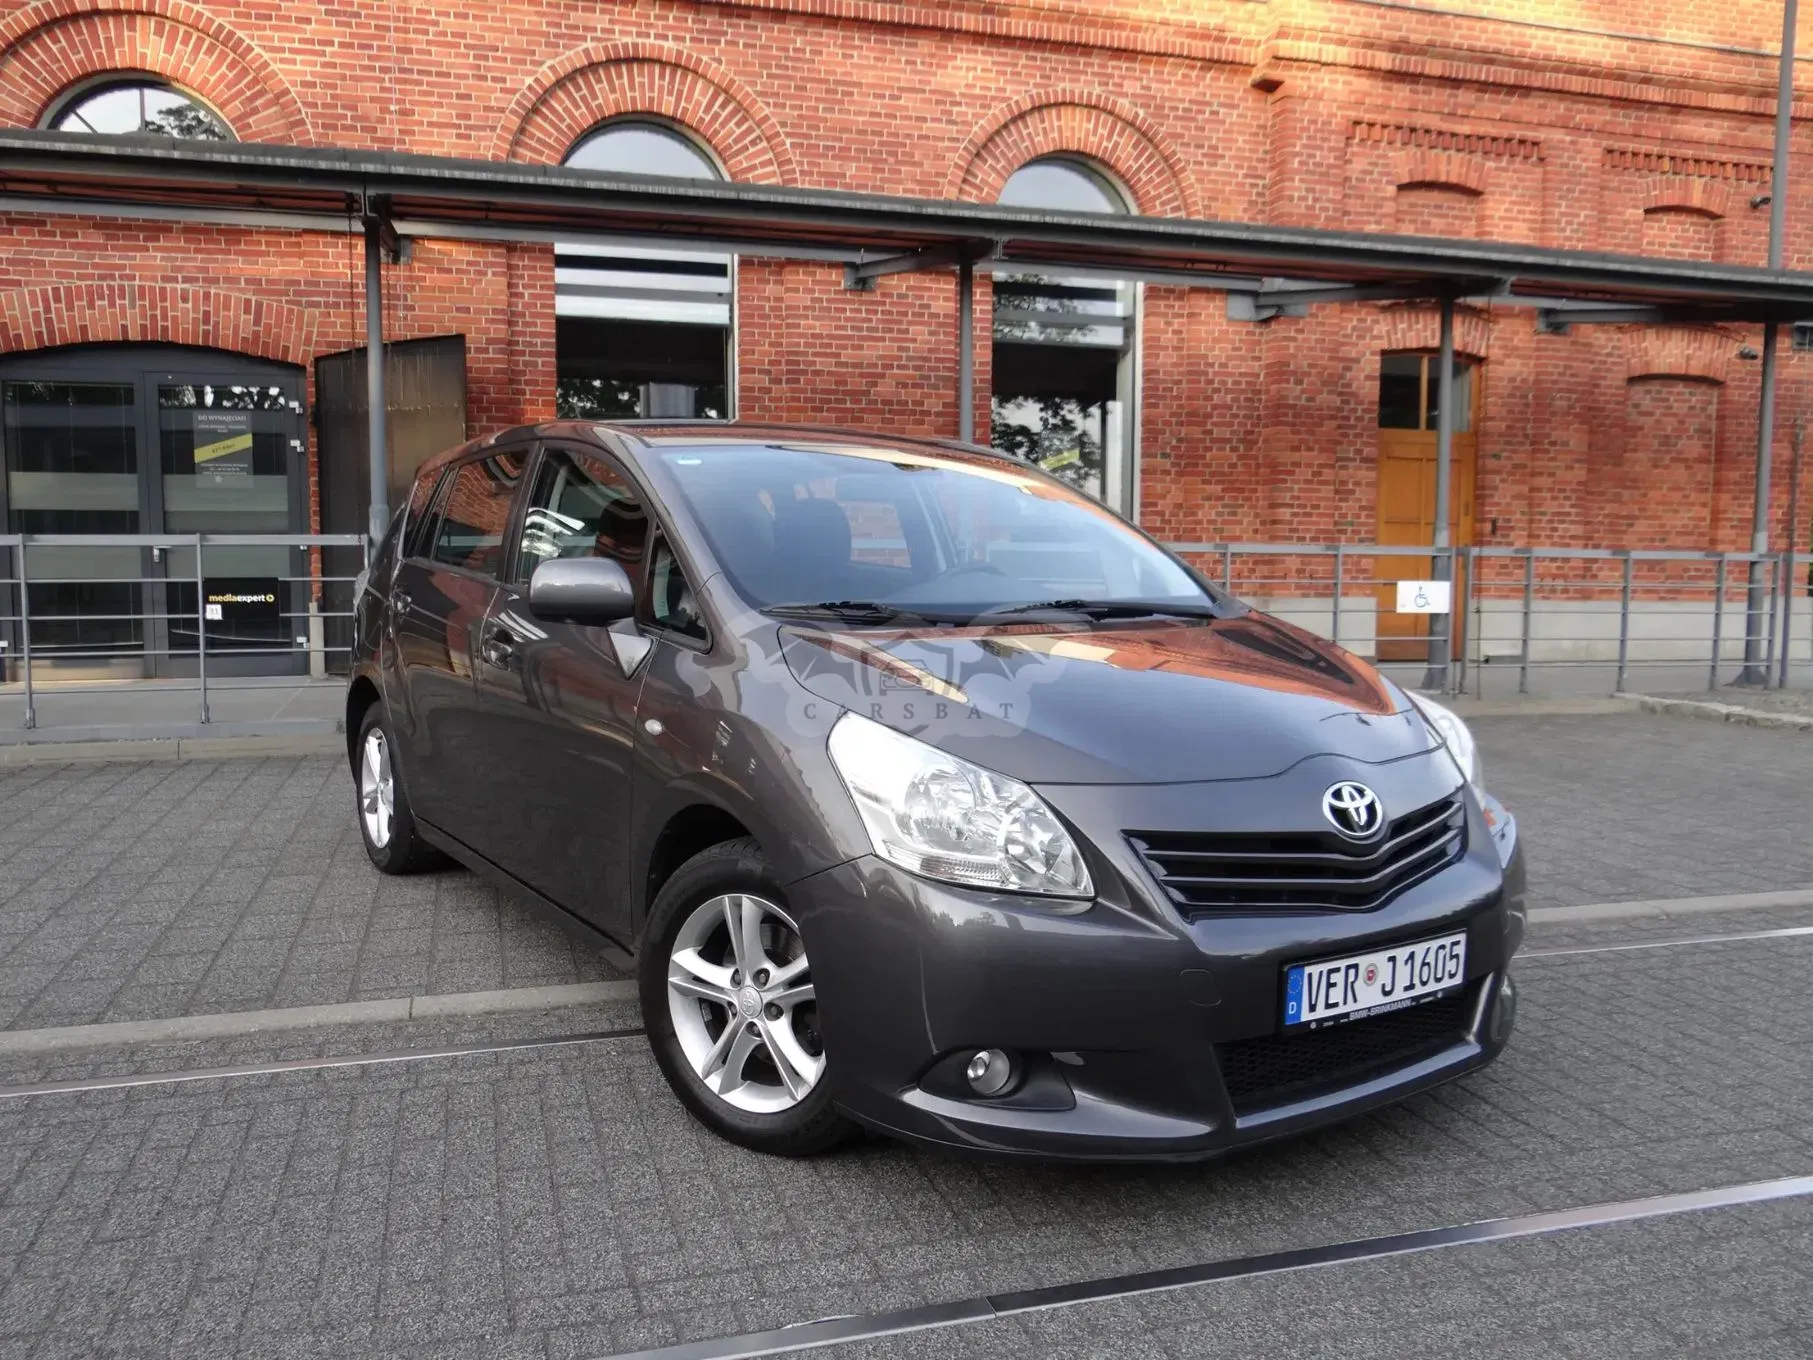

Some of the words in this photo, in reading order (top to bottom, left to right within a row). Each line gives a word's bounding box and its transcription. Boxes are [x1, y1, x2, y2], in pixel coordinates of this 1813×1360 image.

[209, 593, 266, 603] mediaexpert
[1307, 963, 1359, 1013] VER
[1288, 1001, 1297, 1014] D
